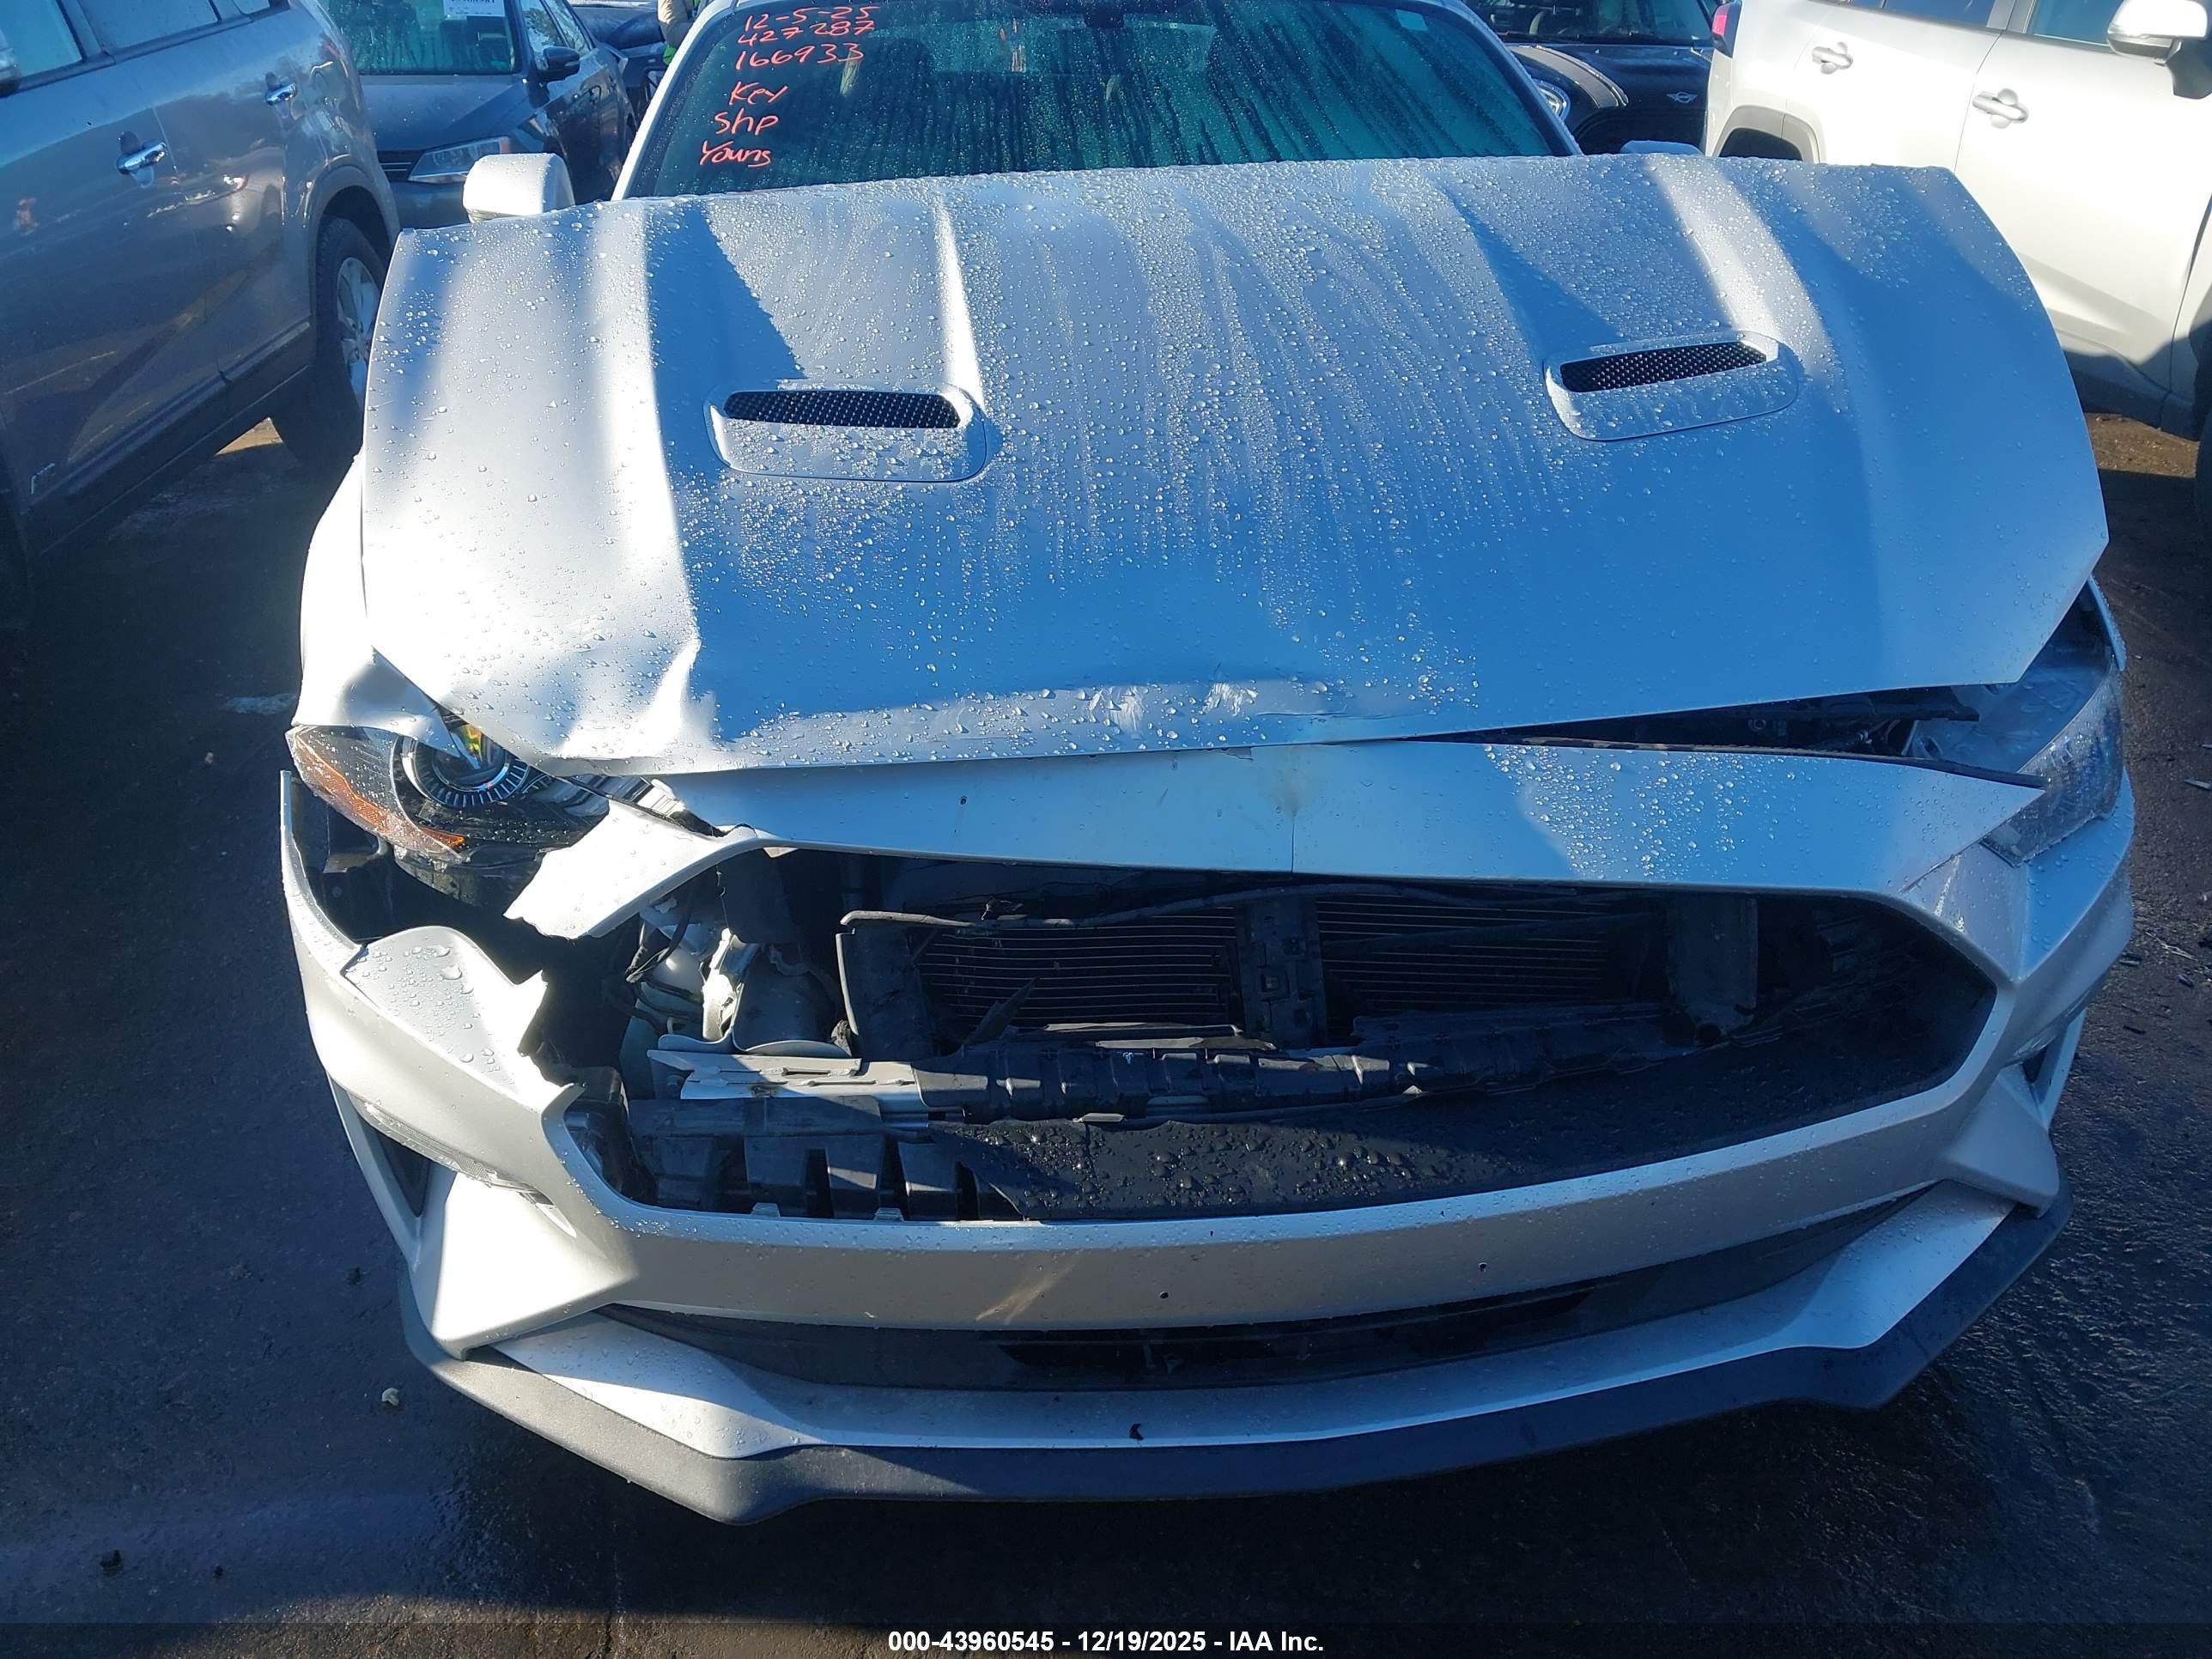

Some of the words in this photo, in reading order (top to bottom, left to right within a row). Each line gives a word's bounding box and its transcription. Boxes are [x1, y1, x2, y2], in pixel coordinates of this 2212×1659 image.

[744, 6, 879, 32] 12-5-25
[736, 43, 864, 70] 166933
[728, 81, 788, 106] Key
